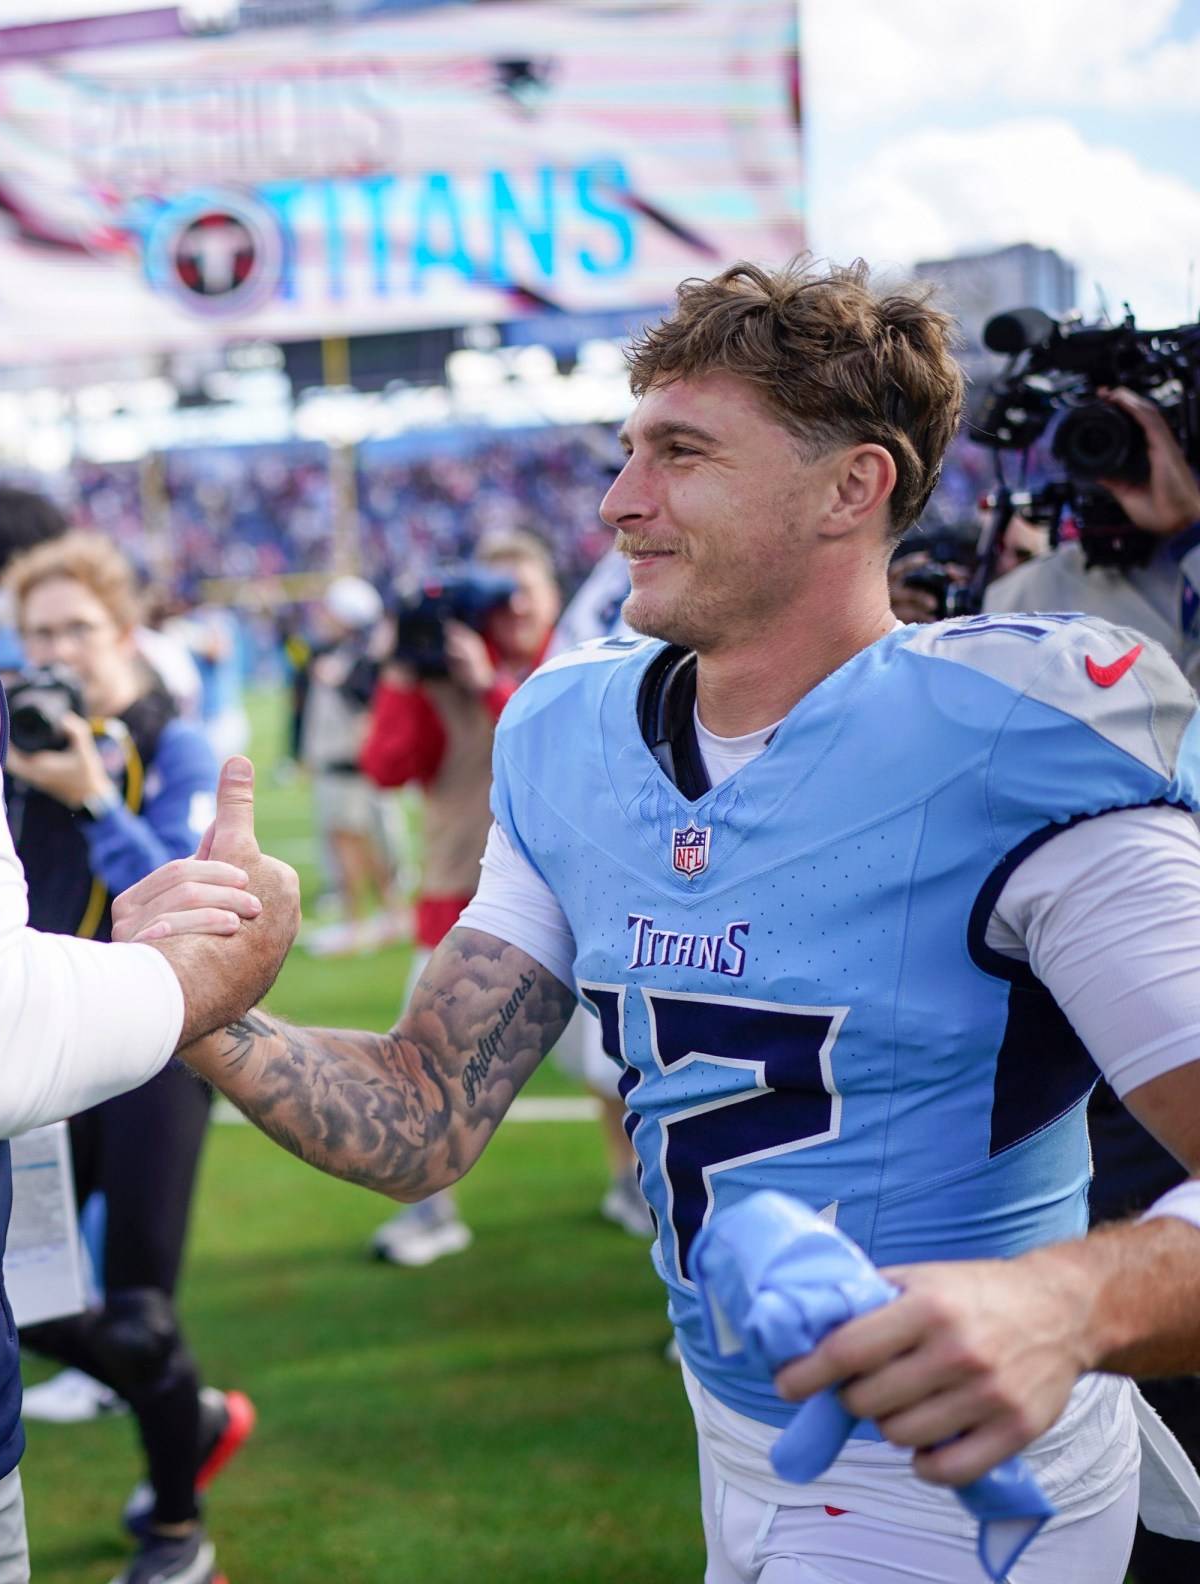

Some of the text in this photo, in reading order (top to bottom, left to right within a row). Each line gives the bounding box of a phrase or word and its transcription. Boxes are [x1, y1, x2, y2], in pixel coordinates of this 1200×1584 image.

[260, 160, 635, 302] TITANS
[676, 847, 702, 870] NFL
[627, 912, 750, 977] TITANS
[461, 969, 537, 1108] Philippians
[576, 979, 851, 1281] 12
